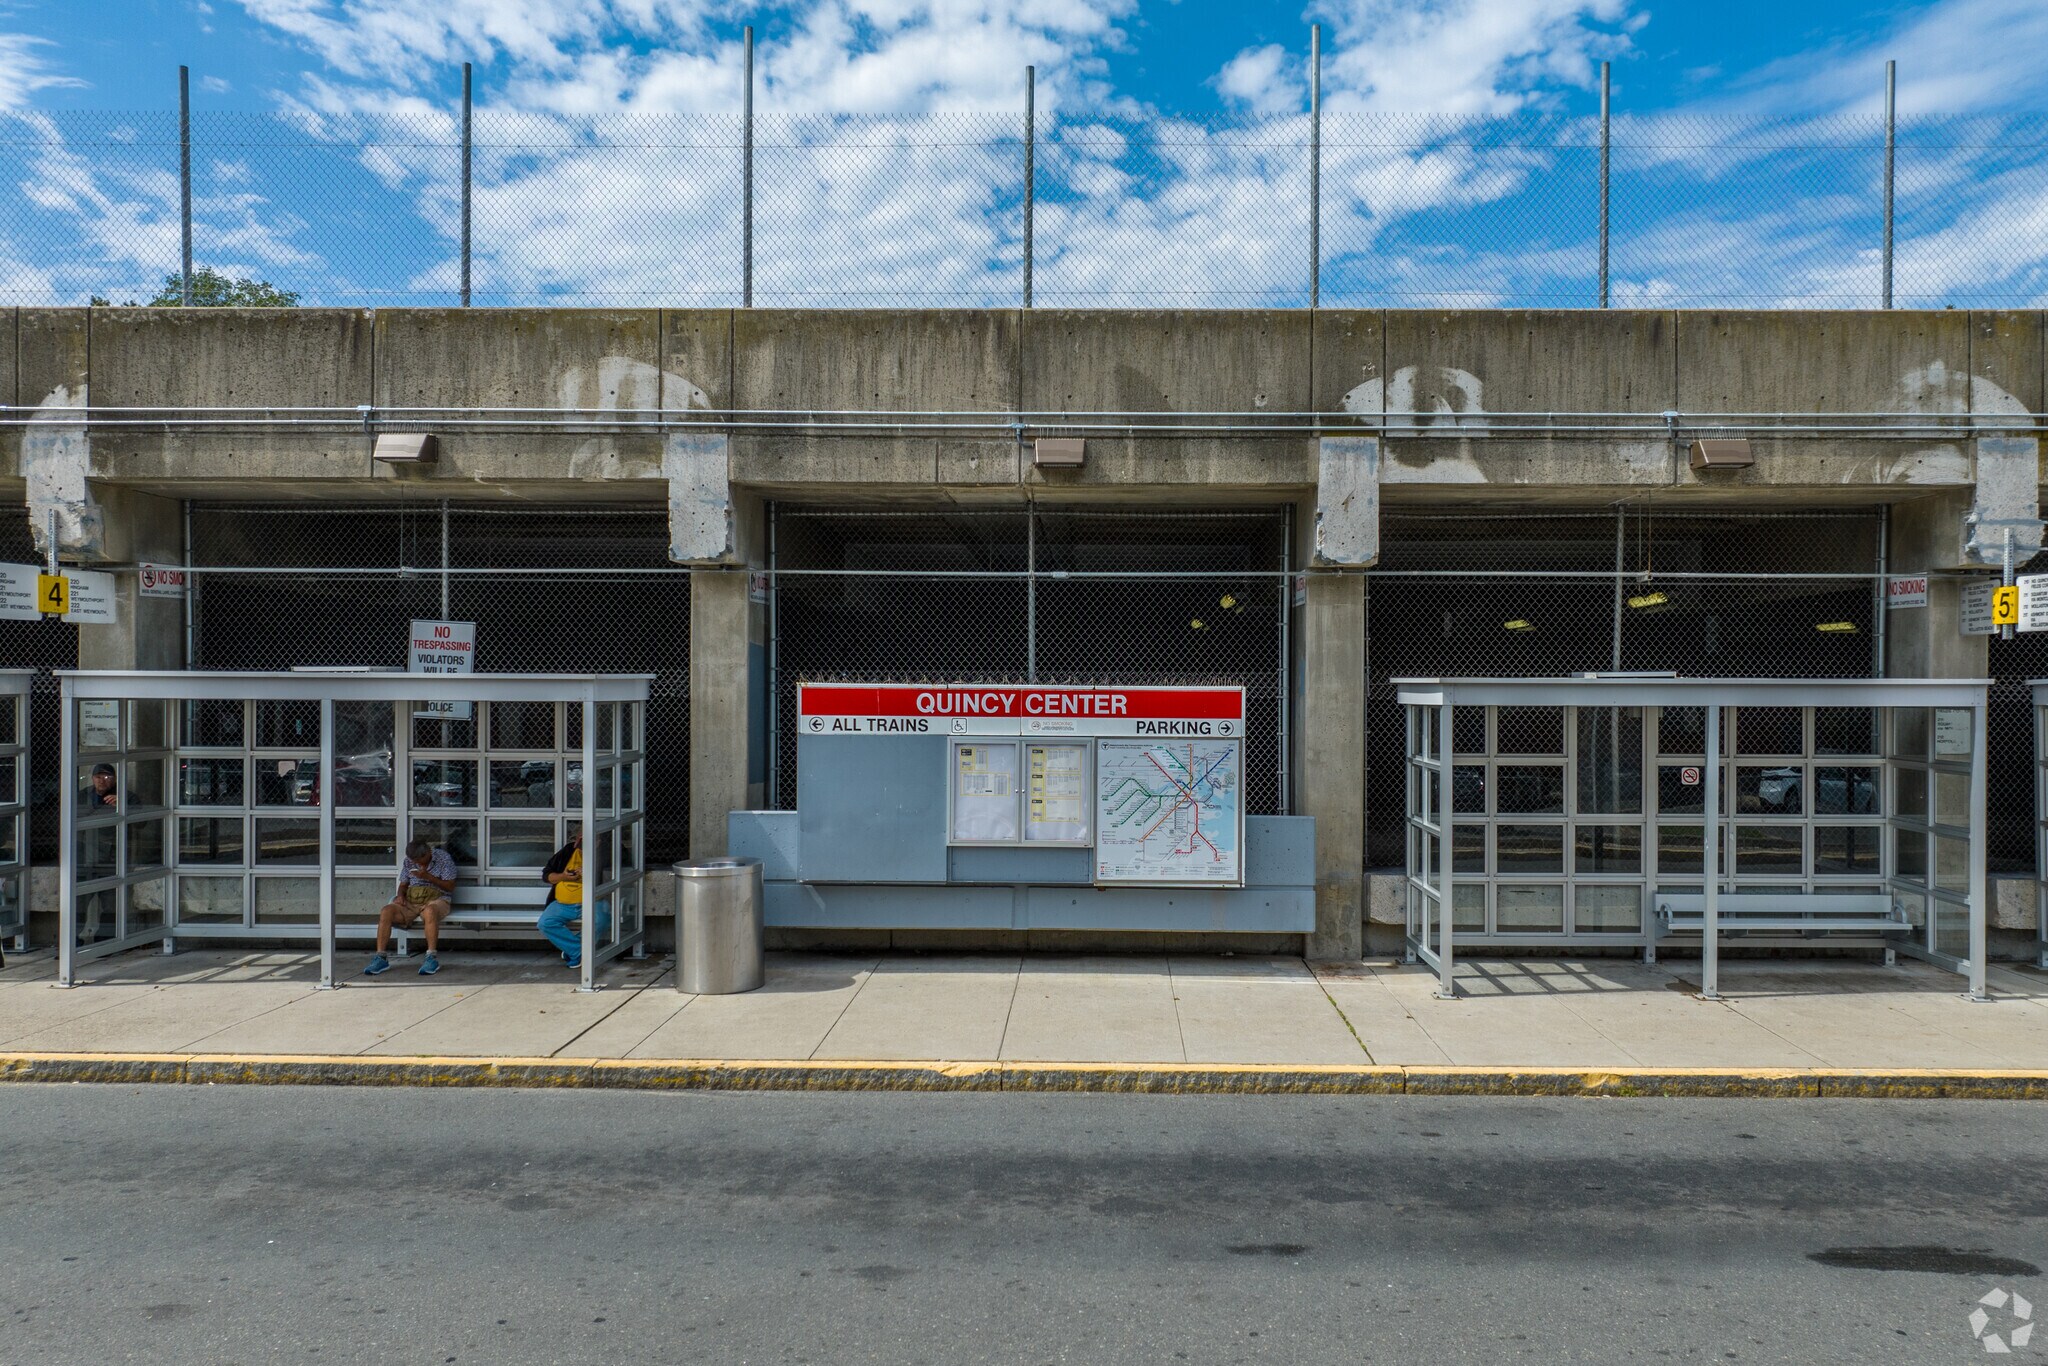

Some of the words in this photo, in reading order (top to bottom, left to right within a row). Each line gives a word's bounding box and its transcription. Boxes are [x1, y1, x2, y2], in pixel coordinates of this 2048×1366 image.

[158, 570, 167, 584] NO
[48, 582, 63, 607] 4
[1889, 582, 1897, 595] NO
[1899, 579, 1925, 595] SMOKING
[1999, 593, 2010, 618] 5
[434, 626, 450, 638] NO
[413, 639, 471, 651] TRESPASSING
[418, 654, 464, 665] VIOLATORS
[428, 702, 454, 712] OLICE
[916, 693, 1016, 714] QUINCY
[1025, 693, 1127, 715] CENTER
[832, 718, 861, 731] ALL
[867, 718, 928, 732] TRAINS
[1136, 720, 1211, 734] PARKING
